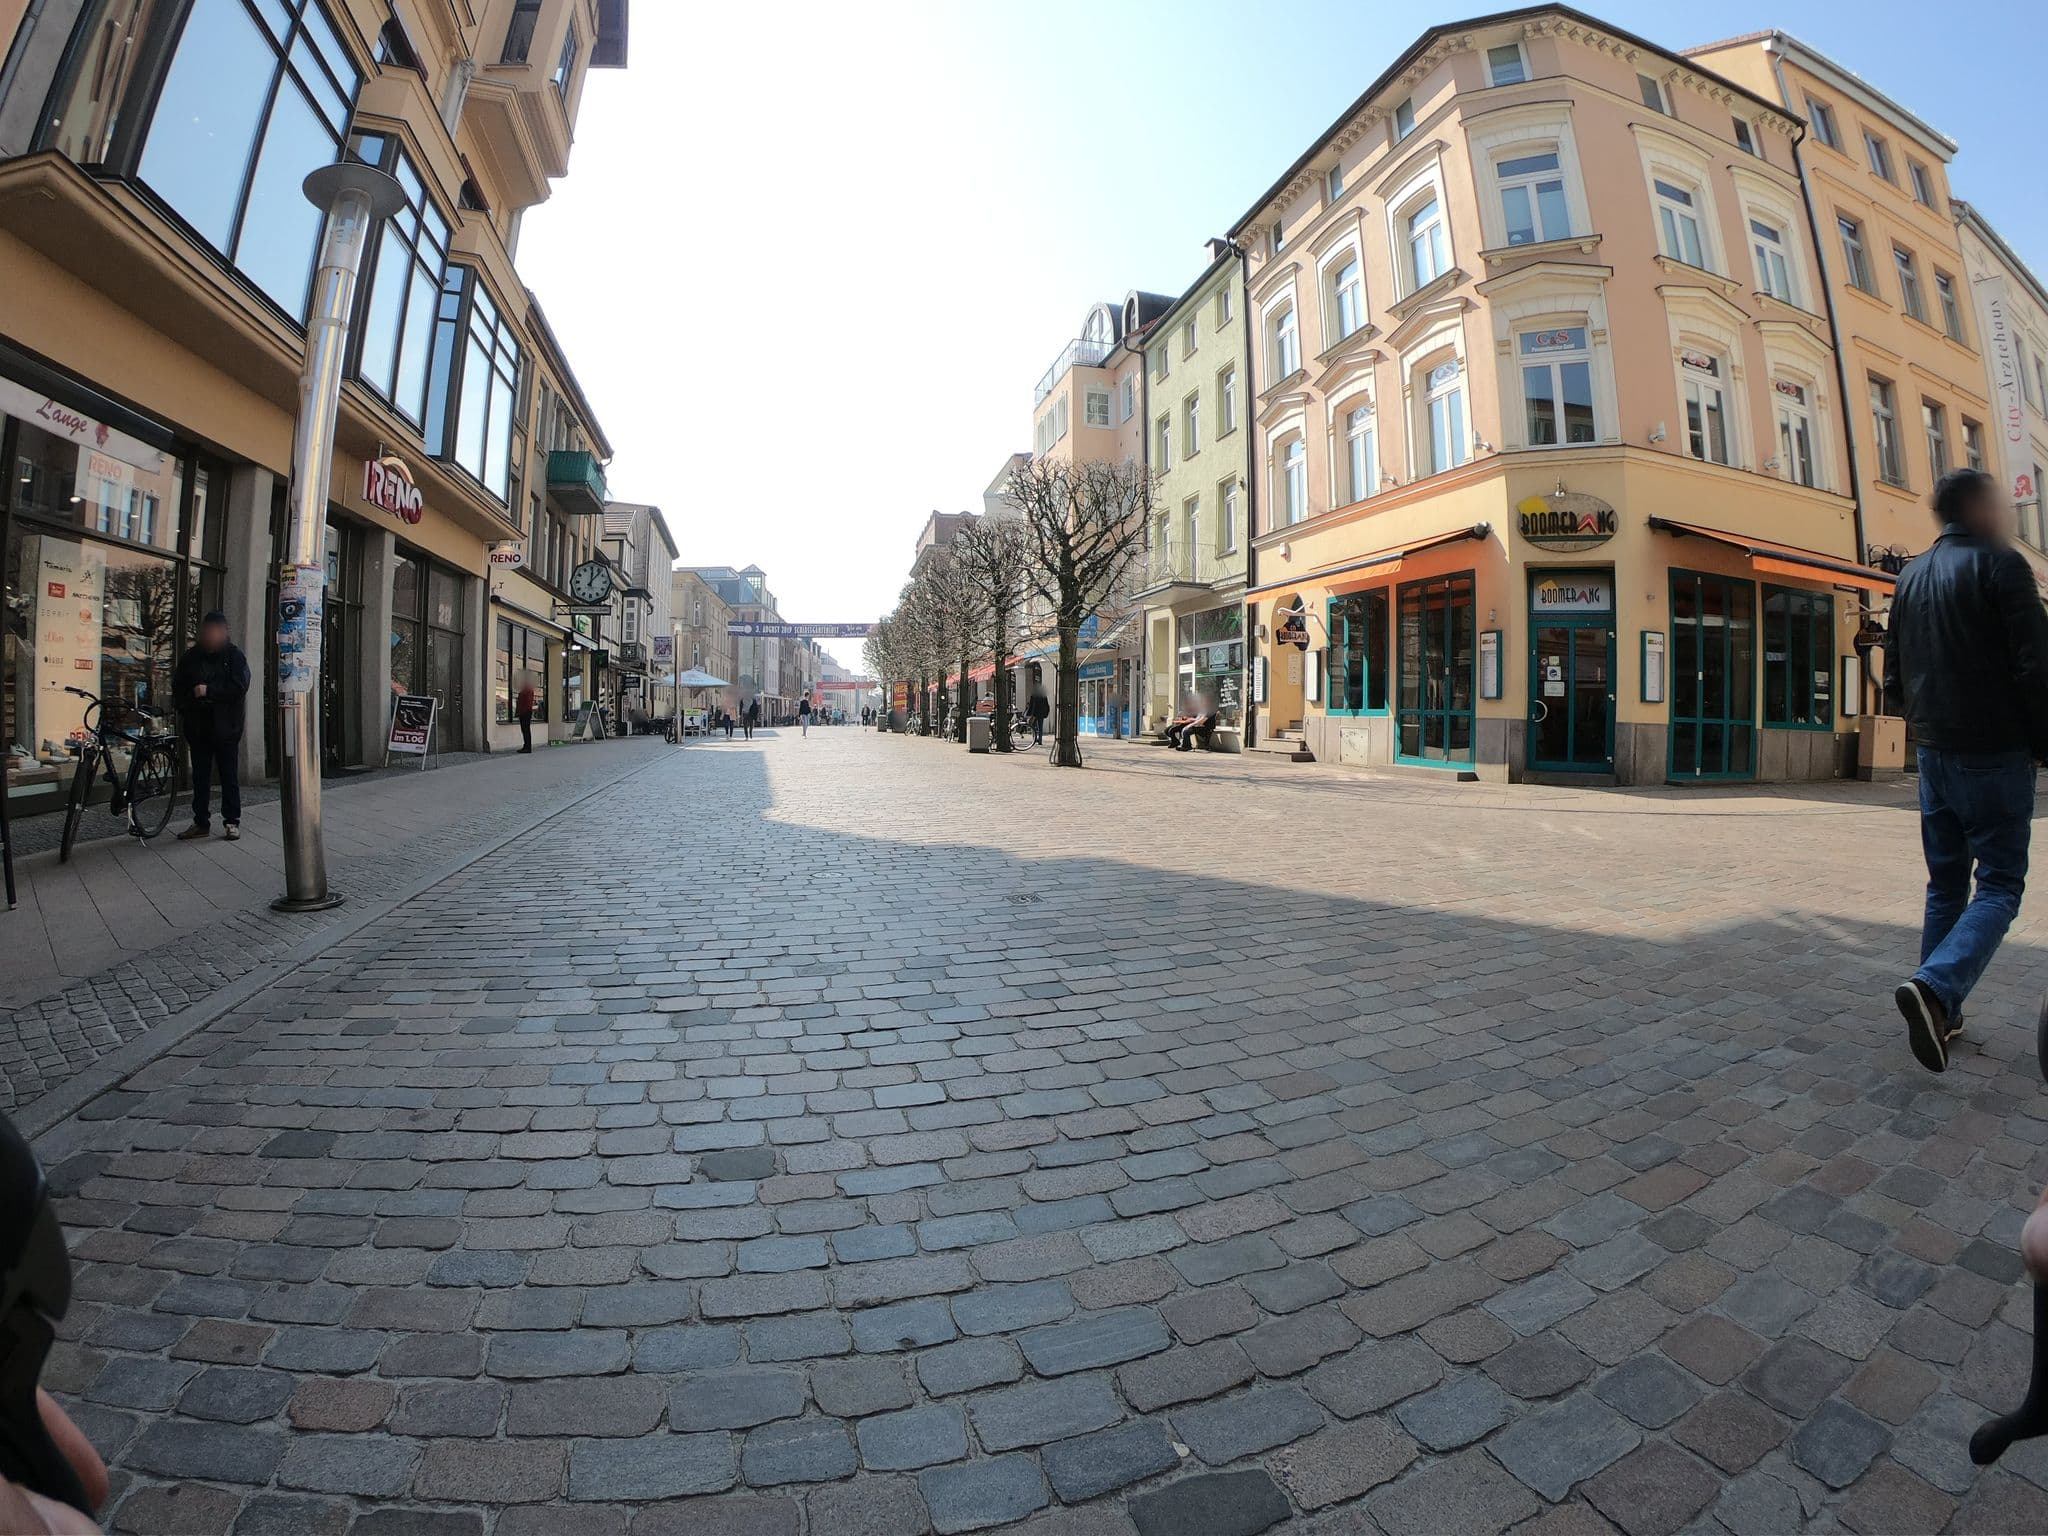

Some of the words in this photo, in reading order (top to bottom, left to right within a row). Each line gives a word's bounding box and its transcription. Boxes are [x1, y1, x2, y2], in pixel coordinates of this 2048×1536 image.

[1990, 300, 2022, 442] City-Ärztehaus
[363, 460, 424, 525] RENO
[1520, 509, 1616, 535] BOOMERANG
[490, 553, 522, 564] RENO
[1541, 586, 1601, 605] BOOMERANG
